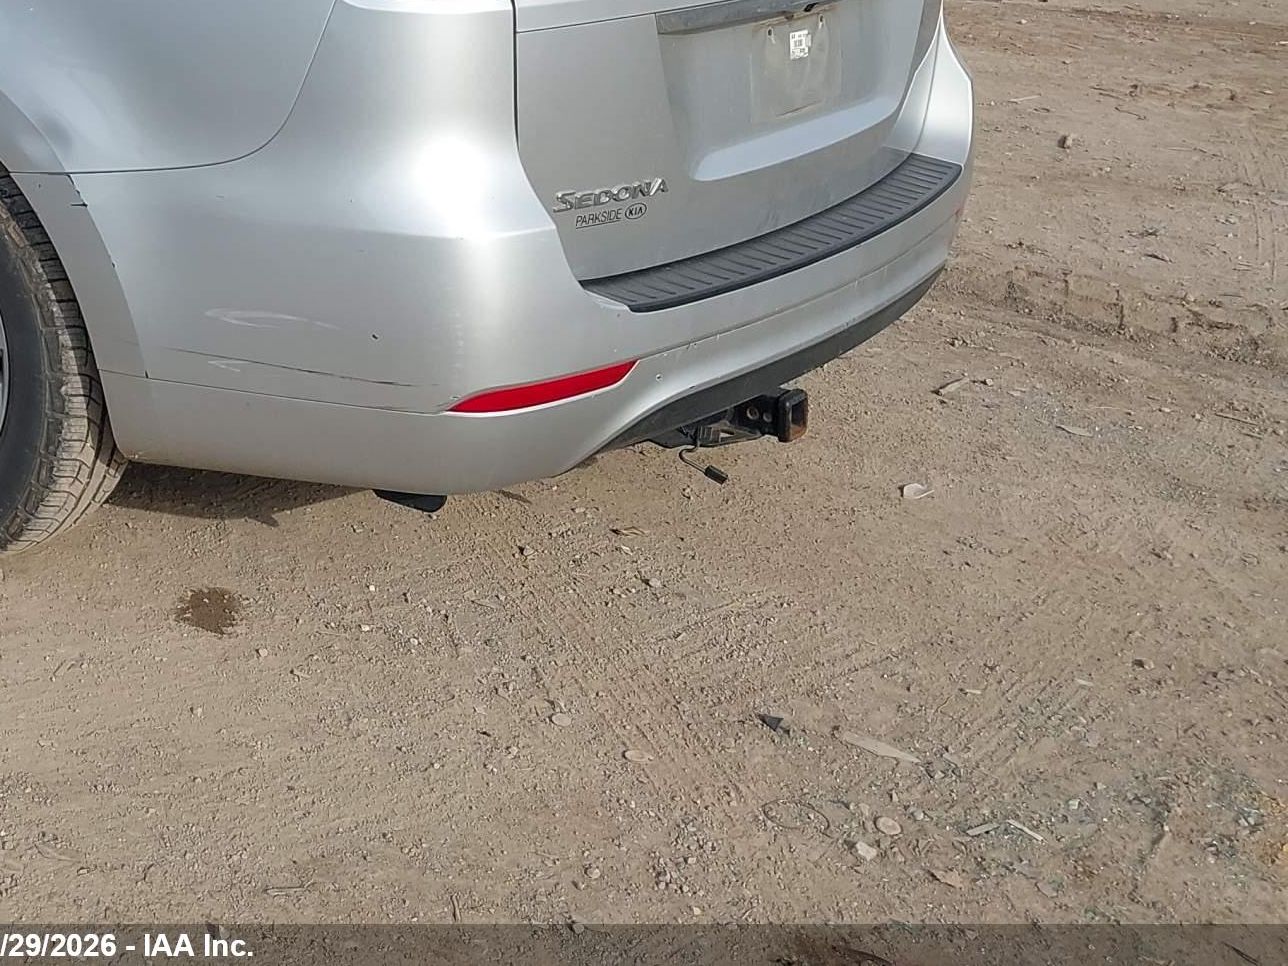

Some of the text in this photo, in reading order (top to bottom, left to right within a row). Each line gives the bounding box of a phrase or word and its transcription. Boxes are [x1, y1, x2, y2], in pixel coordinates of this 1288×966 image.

[552, 177, 669, 213] SEDONA
[575, 205, 644, 227] PARKSIDE KIA
